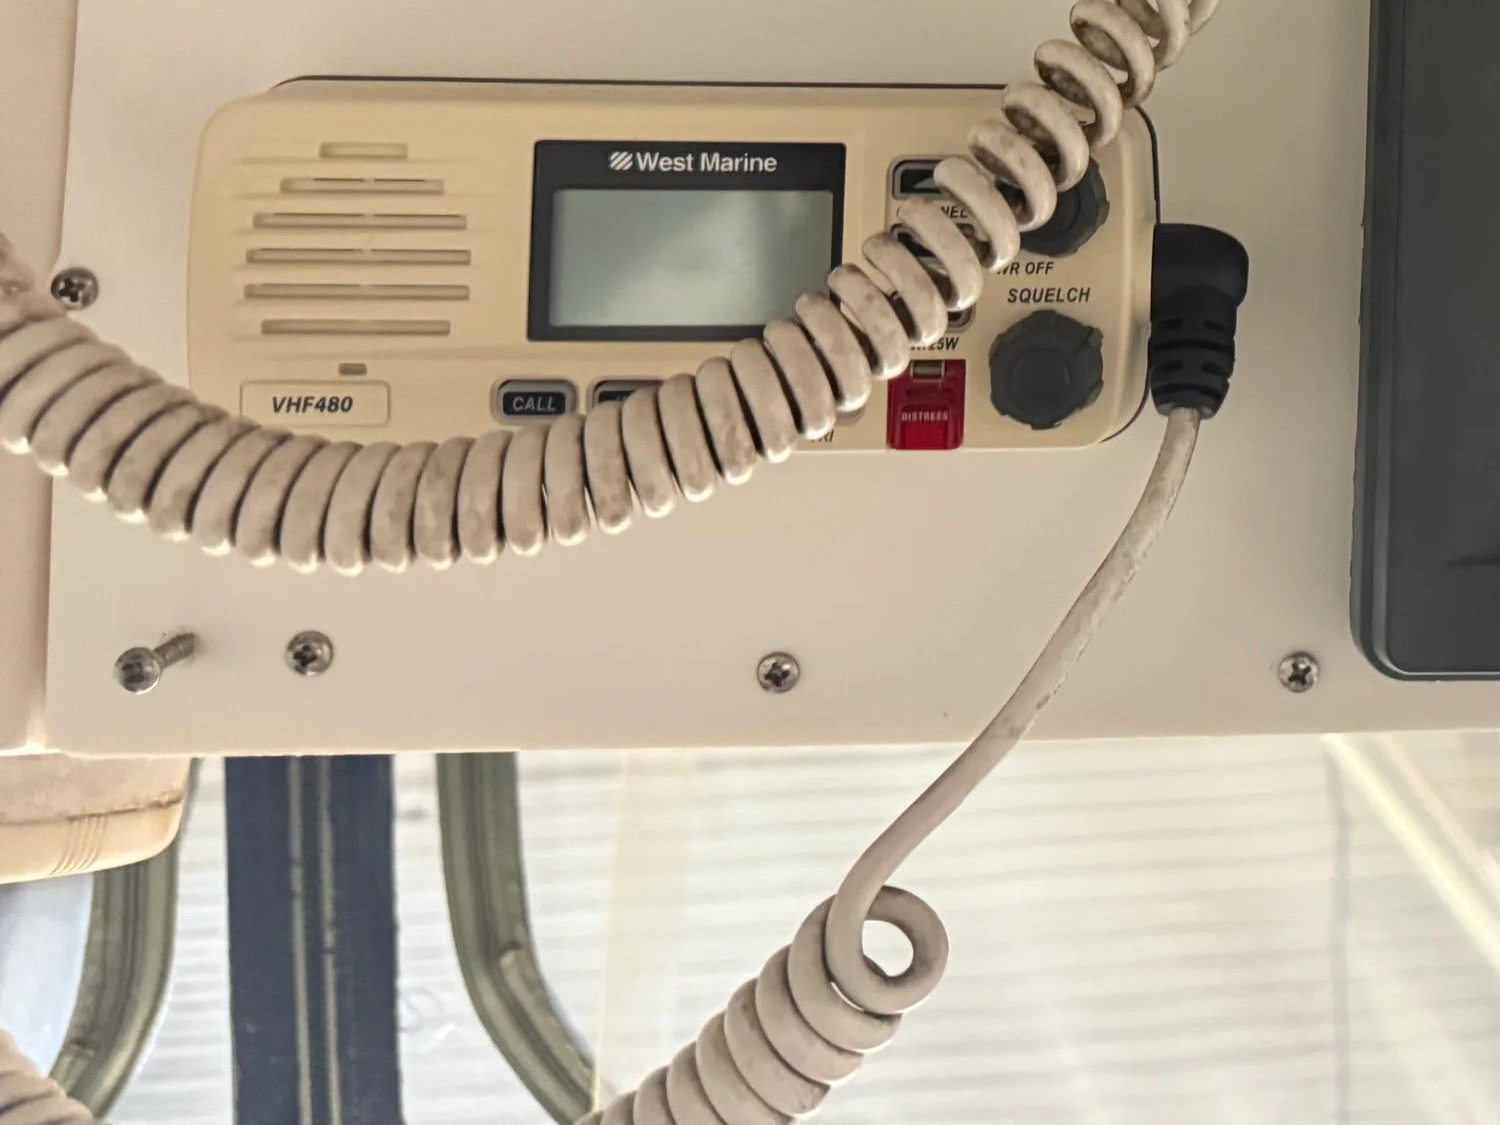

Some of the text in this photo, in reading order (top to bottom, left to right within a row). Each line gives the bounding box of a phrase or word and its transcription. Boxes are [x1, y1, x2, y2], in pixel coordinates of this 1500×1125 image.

[636, 151, 778, 172] West Marine
[1025, 261, 1054, 275] OFF
[1007, 287, 1091, 304] SQUELCH
[272, 395, 354, 413] VHF480
[512, 395, 557, 412] CALL
[901, 411, 949, 421] DISTRESS
